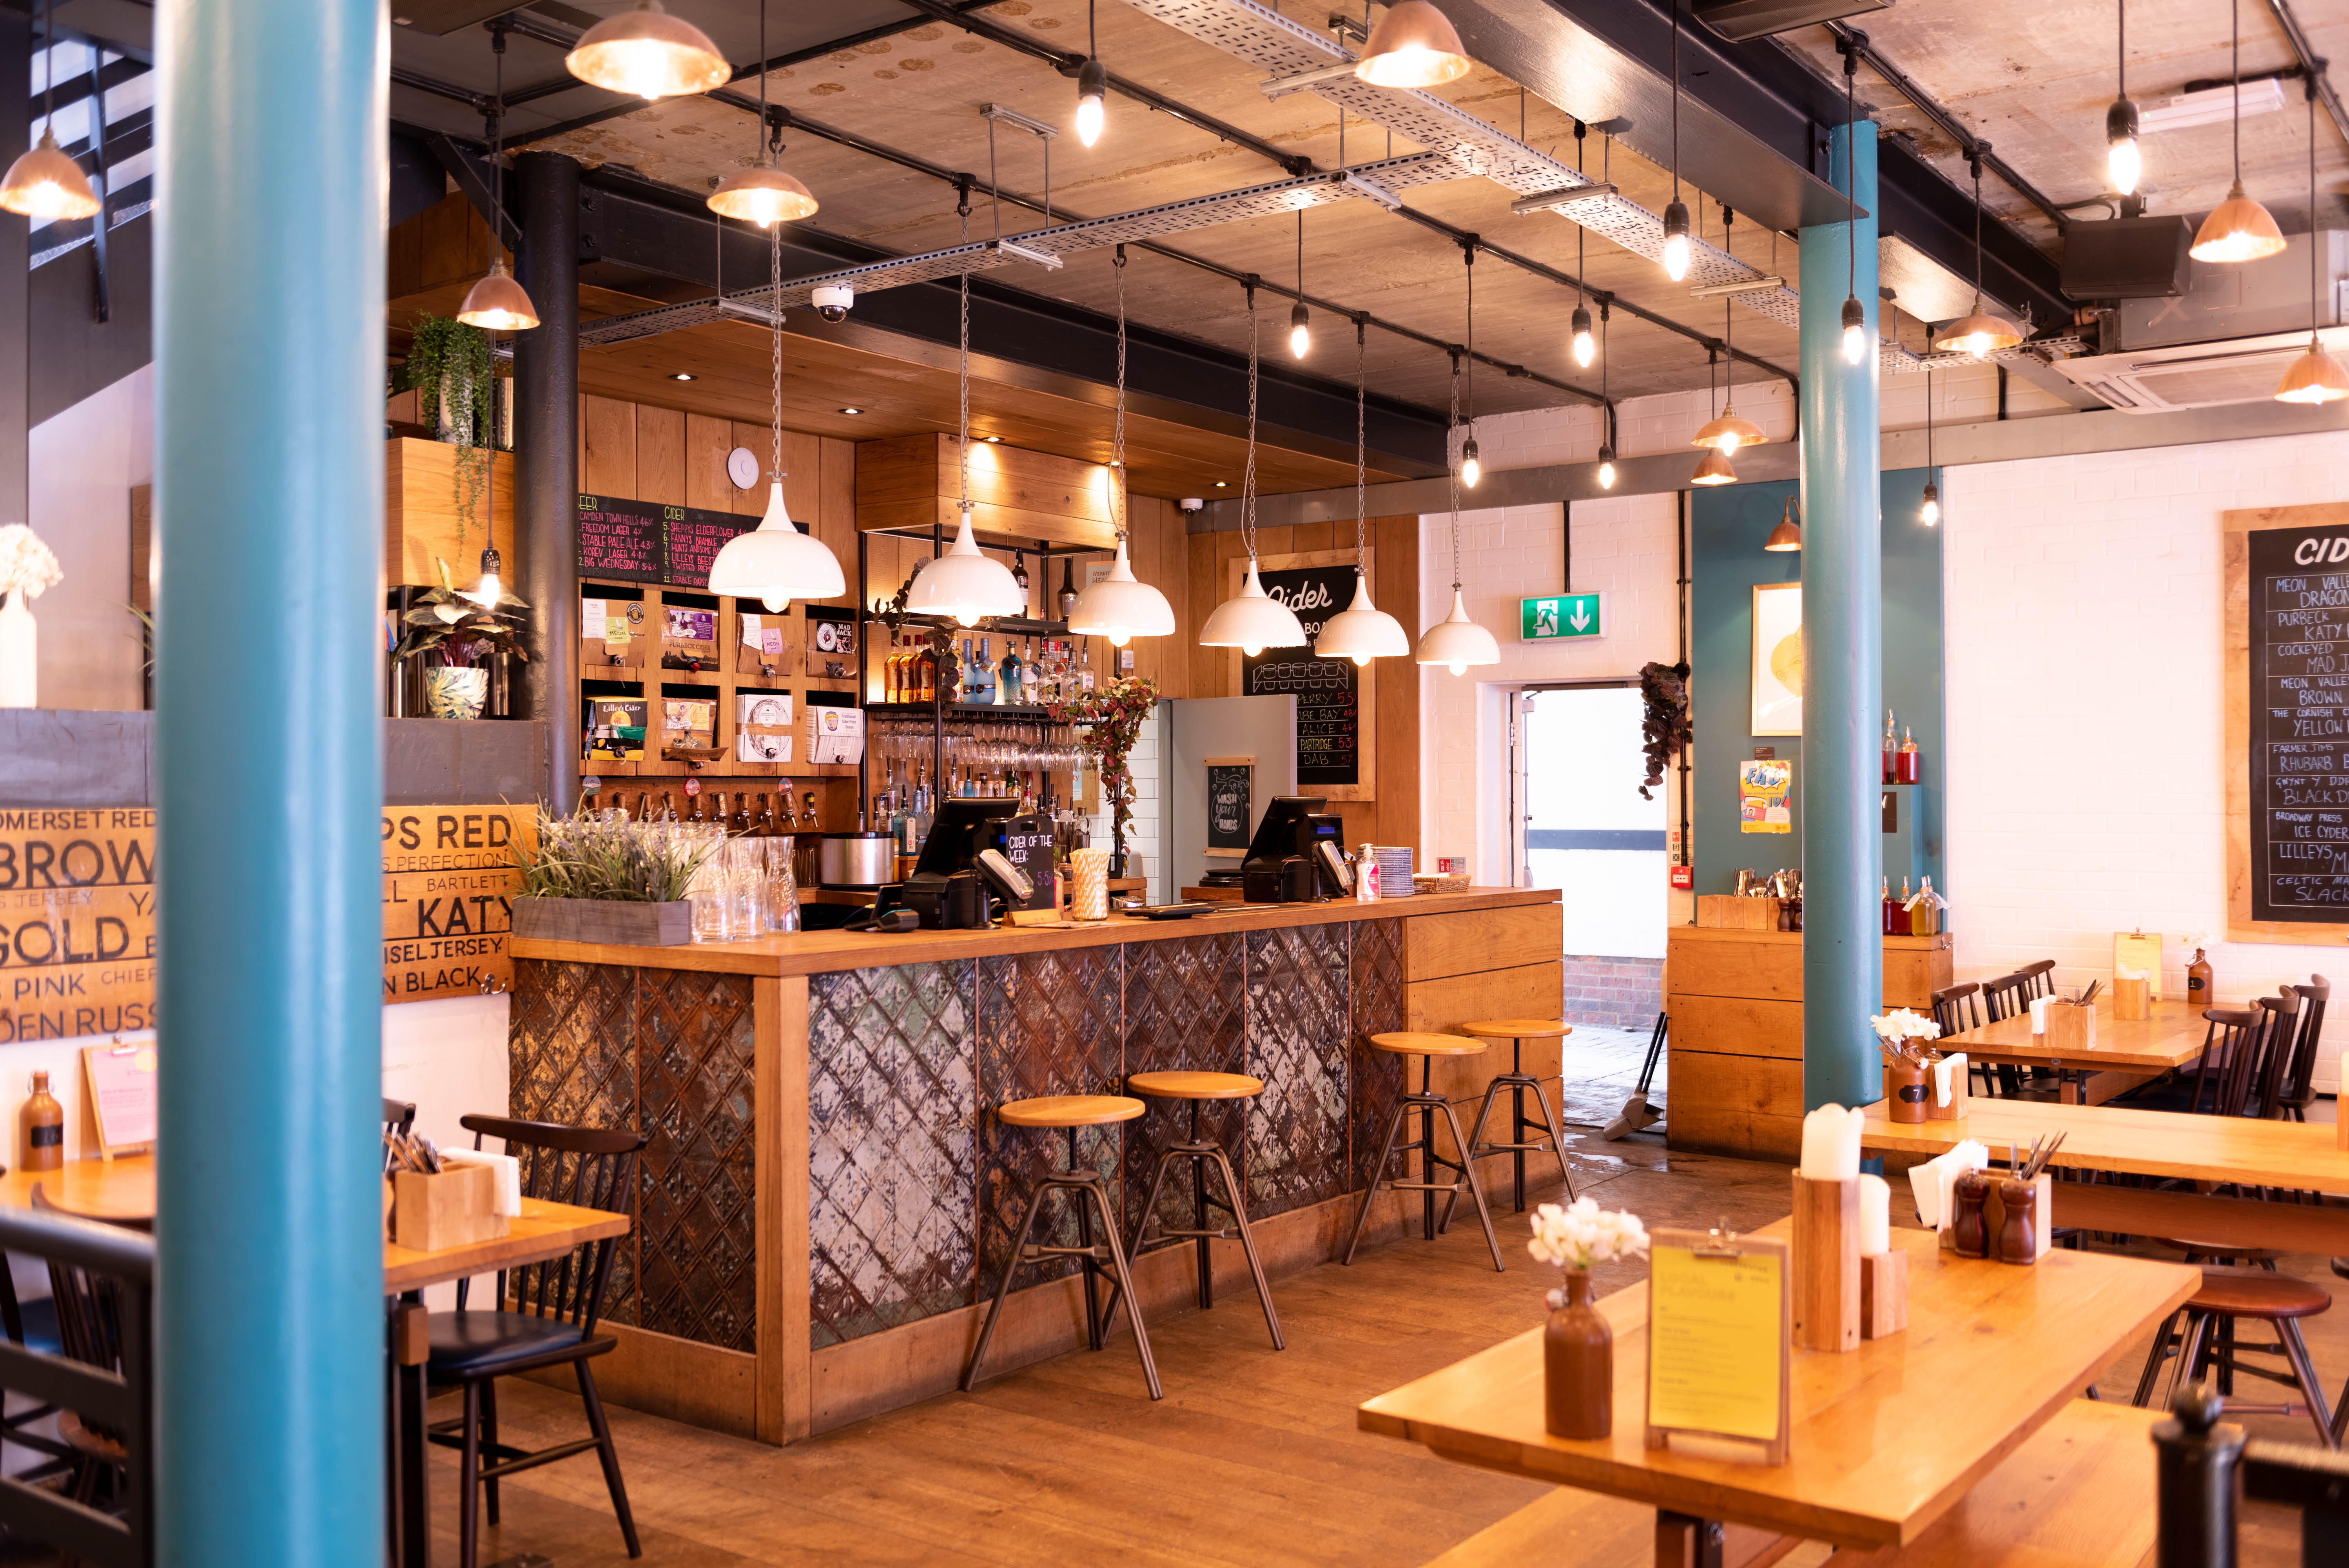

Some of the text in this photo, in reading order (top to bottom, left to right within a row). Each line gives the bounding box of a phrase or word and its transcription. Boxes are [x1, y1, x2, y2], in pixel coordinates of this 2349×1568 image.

[579, 496, 598, 511] EER
[579, 511, 604, 522] CAMDEN
[605, 513, 622, 523] TOWN
[623, 514, 639, 526] HELLS
[664, 506, 685, 520] CIDER
[582, 522, 609, 533] FREEDOM
[612, 525, 629, 535] LAGER
[671, 522, 693, 534] SHEPPYS
[696, 525, 734, 537] ELDERFLOWER
[582, 533, 606, 547] STABLE
[608, 536, 625, 549] PALE
[626, 537, 639, 550] ALE
[671, 533, 692, 544] FANNYS
[695, 537, 717, 546] BRAMBLE
[583, 546, 604, 558] KOREV
[609, 549, 627, 559] LAGER
[671, 543, 687, 553] HUNTS
[689, 545, 711, 555] ANDSOME
[584, 557, 595, 567] BIG
[598, 558, 639, 571] WEDNESDAY
[671, 553, 694, 564] LILLEYS
[672, 562, 695, 571] TWISTED
[672, 575, 691, 584] STABLE
[2276, 578, 2307, 592] MEON
[2278, 610, 2330, 627] PURBECK
[2305, 624, 2342, 641] KATY
[2278, 643, 2334, 656] COCKEYED
[2306, 656, 2335, 673] MAD
[2280, 678, 2309, 689] MEON
[1297, 693, 1332, 704] PERRY
[2299, 690, 2343, 705] BROWN
[1320, 709, 1340, 720] BAY
[2272, 709, 2289, 718] THE
[2297, 708, 2333, 718] CORNISH
[1303, 723, 1336, 736] ALICE
[2293, 719, 2343, 737] YELLOW
[1301, 738, 1332, 751] PARTRIDGE
[2273, 744, 2334, 753] FARMER JIMS
[1304, 753, 1329, 765] DAB
[2280, 756, 2333, 772] RHUBARB
[2276, 777, 2306, 789] GWYNT
[2311, 777, 2321, 787] Y
[1217, 793, 1237, 805] WASH
[2283, 789, 2334, 805] BLACK
[1215, 803, 1236, 823] your
[2276, 811, 2343, 823] BROADWAY PRESS
[0, 811, 104, 830] MERSET
[1219, 819, 1238, 830] HANDS
[437, 815, 511, 849] RED
[2295, 825, 2349, 839] ICE CYDER
[1009, 835, 1052, 849] CIDER OF THE
[1009, 849, 1028, 863] WEEK:
[2280, 843, 2333, 859] LILLEYS
[397, 853, 507, 872] PERFECTION
[428, 874, 510, 892] BARTLETT
[2276, 876, 2323, 885] CELTIC
[15, 890, 94, 908] JERSEY
[0, 917, 129, 966] OLD
[430, 937, 502, 959] JERSEY
[406, 966, 482, 992] BLACK
[15, 973, 87, 1001] PINK
[1913, 1089, 1920, 1099] 7
